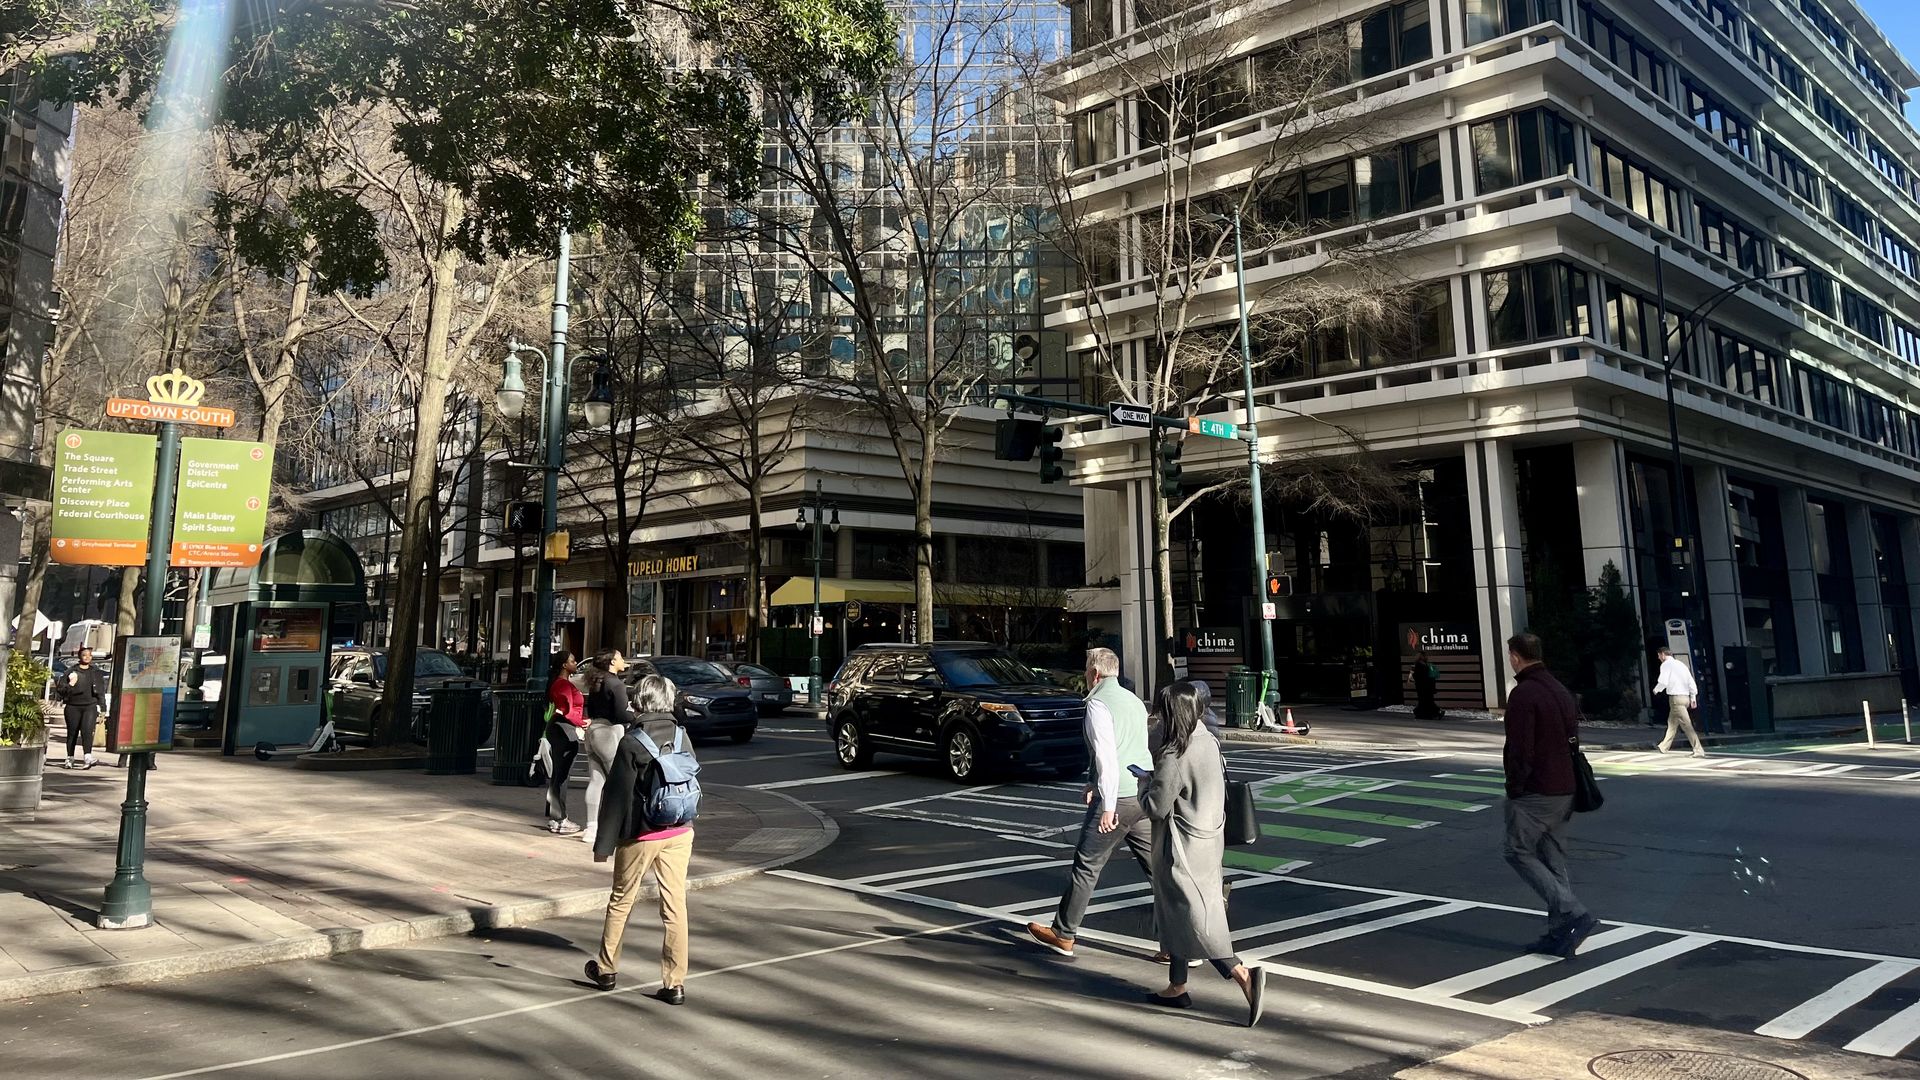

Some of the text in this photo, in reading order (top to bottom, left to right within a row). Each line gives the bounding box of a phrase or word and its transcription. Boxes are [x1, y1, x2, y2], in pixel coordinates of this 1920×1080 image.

[111, 402, 231, 424] UPTOWN SOUTH
[1122, 410, 1147, 421] ONE WAY
[1201, 421, 1209, 433] E.
[1211, 423, 1224, 436] 4TH
[65, 452, 115, 463] The Square
[64, 464, 118, 475] Trade Street
[188, 460, 239, 470] Government
[187, 468, 219, 477] District
[62, 476, 133, 488] Performing Arts
[186, 480, 228, 489] EpiCentre
[61, 485, 91, 494] Center
[60, 497, 130, 508] Discovery Place
[58, 509, 145, 520] Federal Courthouse
[183, 511, 236, 523] Main Library
[182, 523, 236, 533] Spirit Square
[627, 554, 699, 576] TUPELO HONEY
[1197, 632, 1235, 647] chima
[1421, 627, 1469, 643] chima
